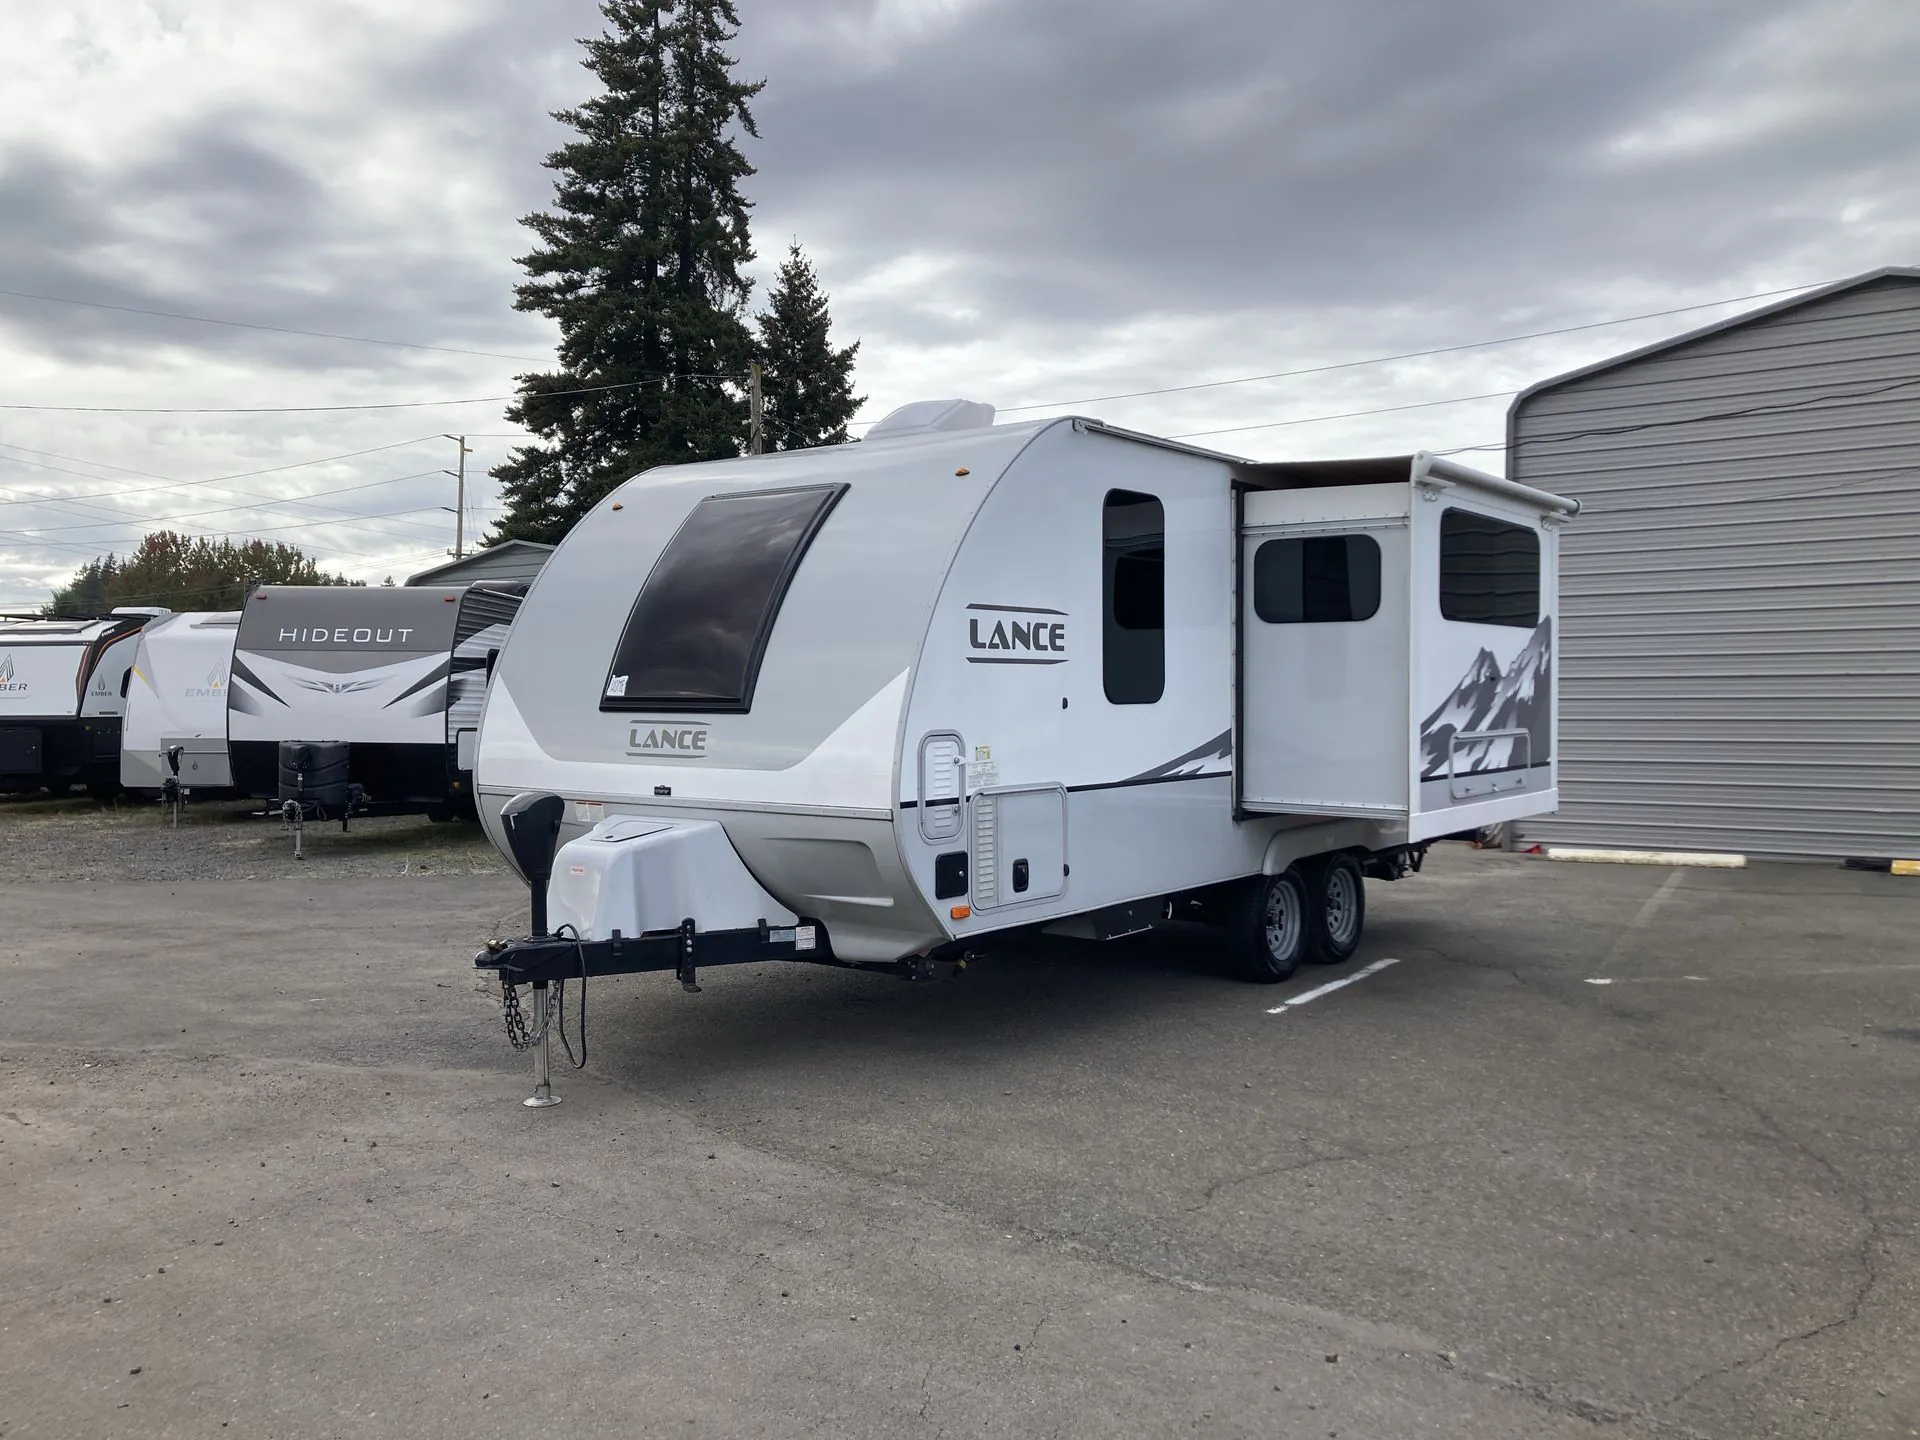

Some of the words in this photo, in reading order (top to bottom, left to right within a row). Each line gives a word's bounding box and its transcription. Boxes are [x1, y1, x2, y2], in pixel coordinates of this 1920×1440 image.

[278, 628, 414, 643] HIDEOUT
[969, 618, 1065, 651] LANCE
[629, 728, 708, 751] LANCE
